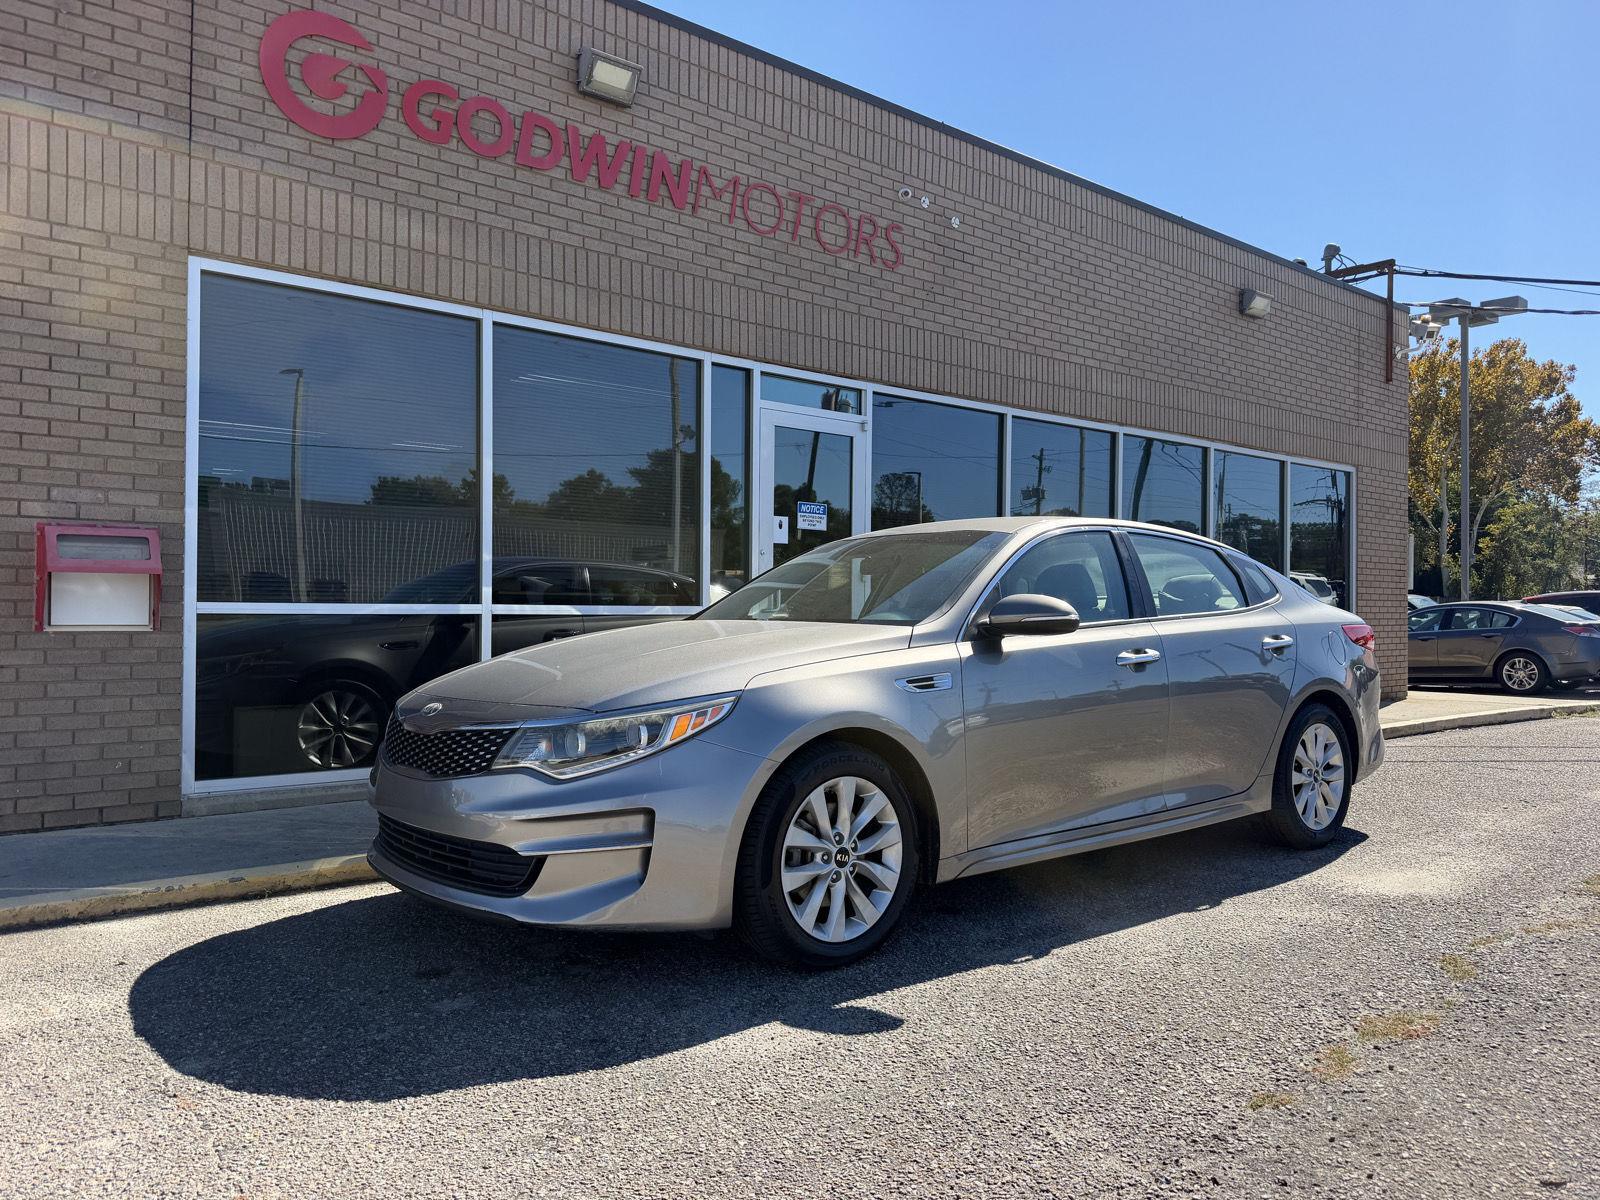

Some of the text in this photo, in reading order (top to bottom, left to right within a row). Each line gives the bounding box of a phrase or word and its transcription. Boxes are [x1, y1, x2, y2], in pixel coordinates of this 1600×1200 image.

[402, 80, 904, 269] GODWIN MOTORS
[800, 504, 825, 514] NOTICE
[836, 853, 848, 862] KIA
